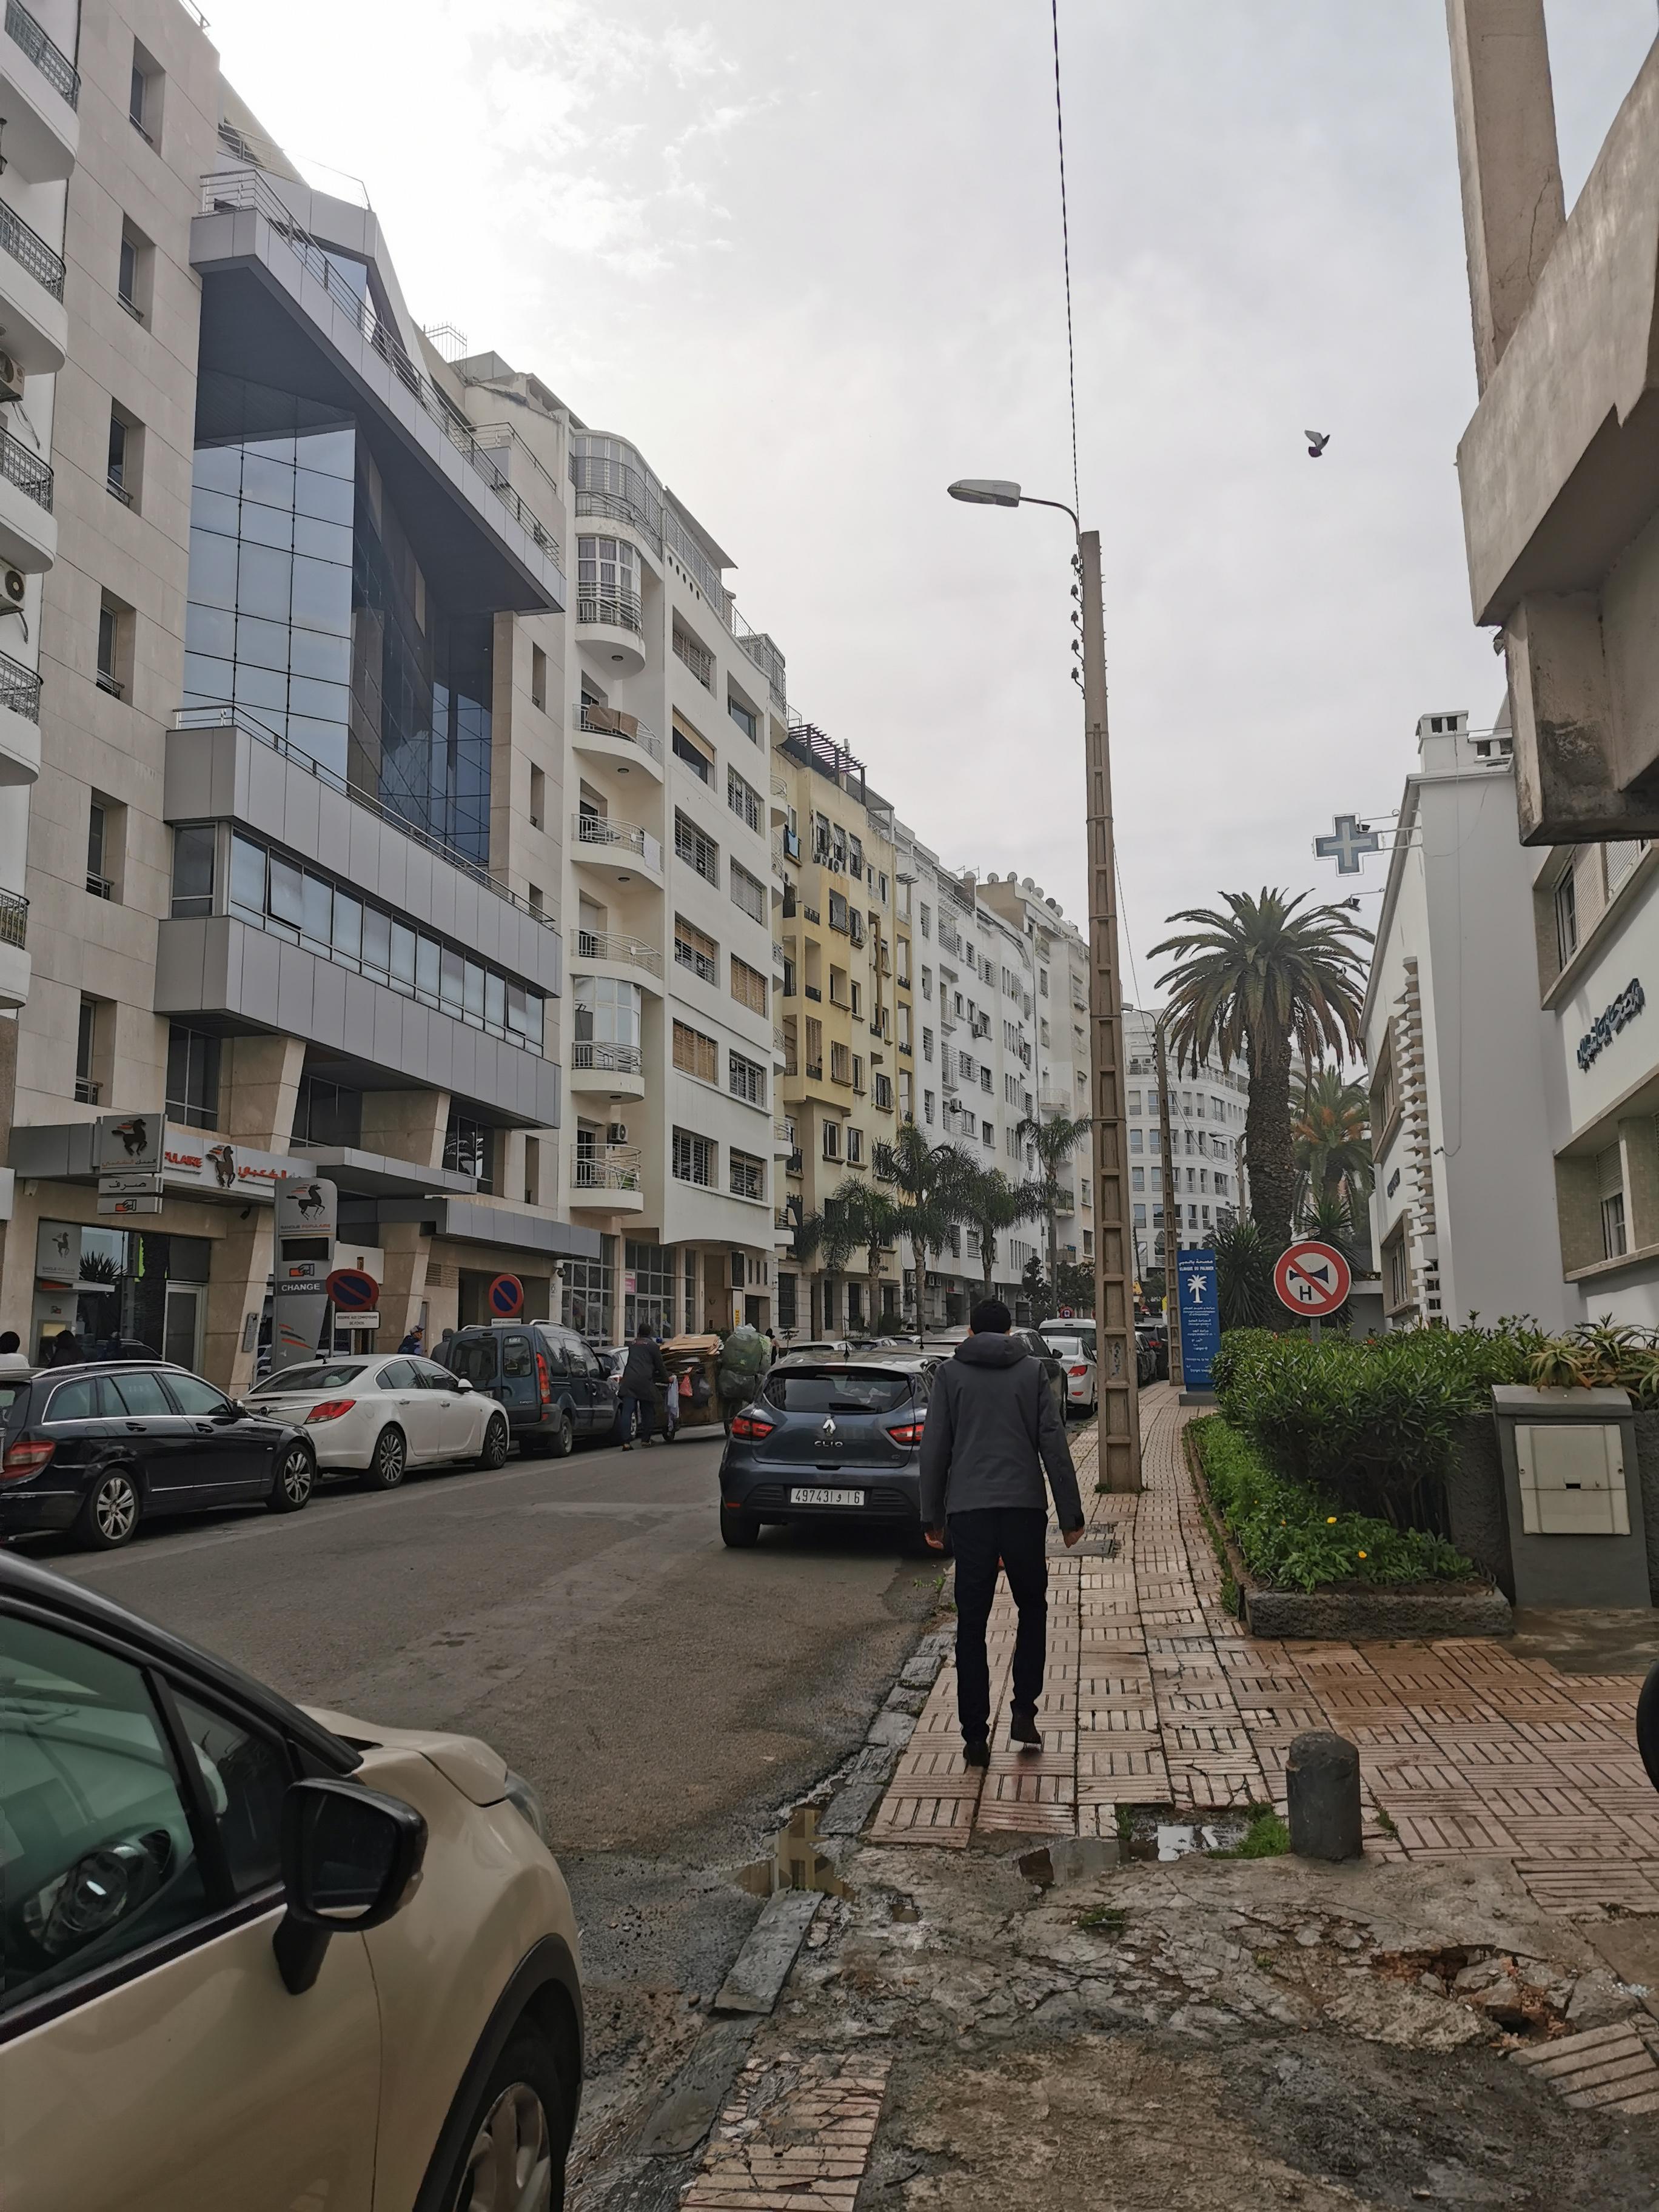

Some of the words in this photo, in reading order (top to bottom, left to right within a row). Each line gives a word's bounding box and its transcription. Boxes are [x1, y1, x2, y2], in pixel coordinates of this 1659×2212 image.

[109, 1181, 146, 1190] صرف
[281, 1283, 320, 1292] CHANGE
[1299, 1285, 1312, 1300] H
